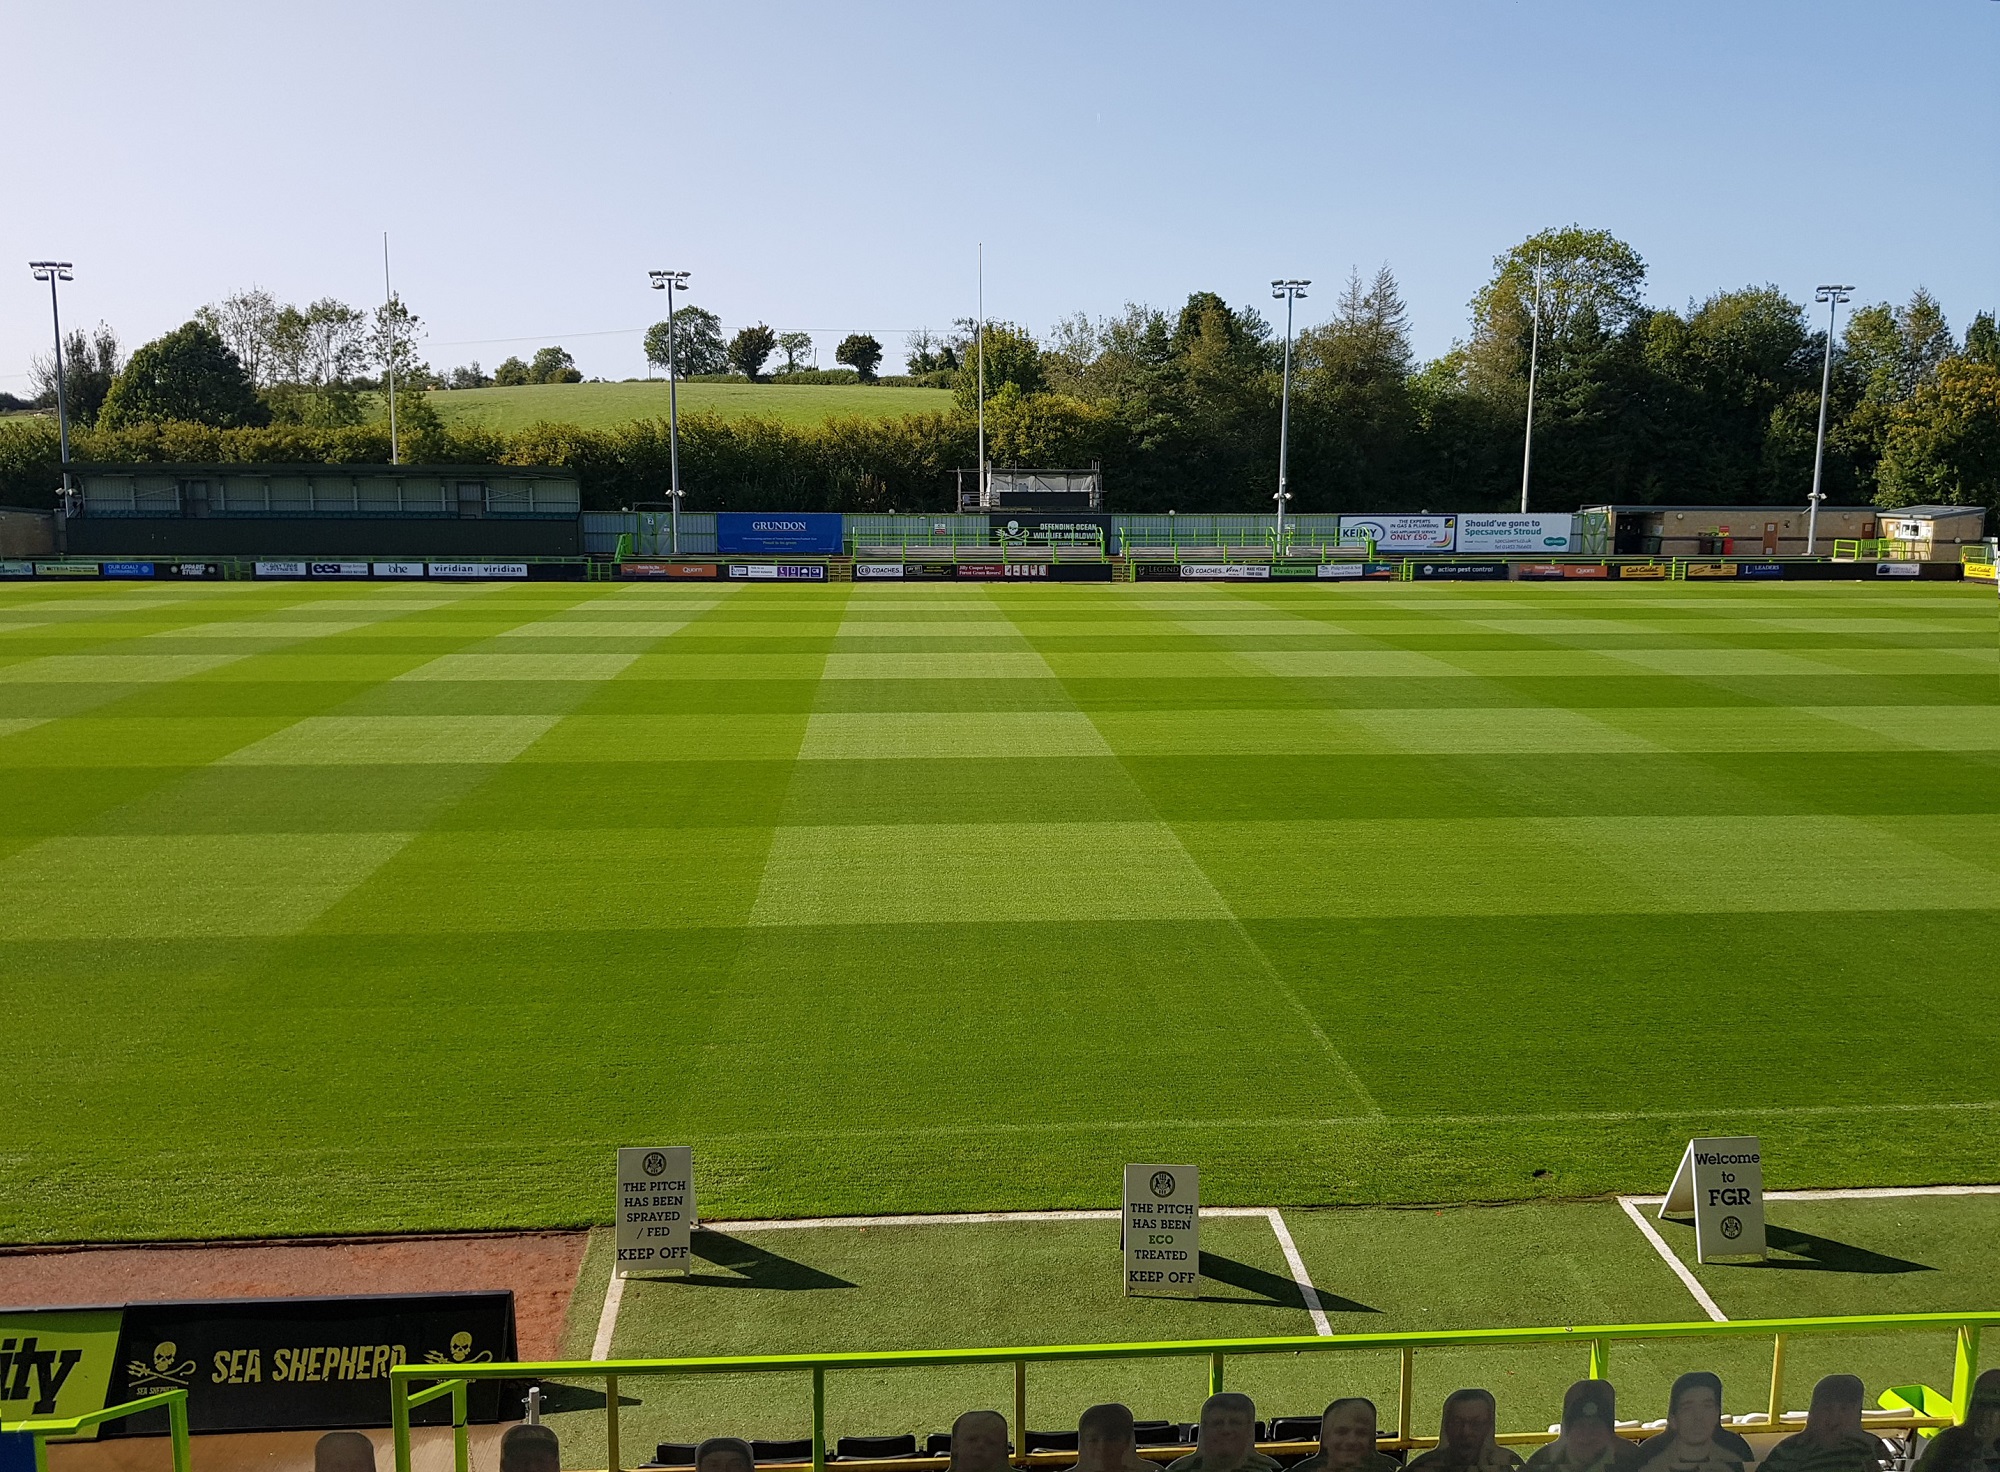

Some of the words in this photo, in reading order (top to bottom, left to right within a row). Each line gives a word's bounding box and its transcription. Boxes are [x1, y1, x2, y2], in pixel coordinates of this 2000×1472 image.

[752, 522, 807, 530] GRUNDON
[1465, 528, 1512, 536] Specsavers
[484, 565, 522, 573] viridian
[1695, 1153, 1760, 1165] Welcome
[1722, 1171, 1735, 1182] to
[623, 1182, 646, 1192] THE
[650, 1181, 686, 1191] PITCH
[624, 1198, 648, 1207] HAS
[652, 1196, 683, 1206] BEEN
[1708, 1188, 1751, 1206] FGR
[1131, 1203, 1153, 1213] THE
[1157, 1204, 1193, 1214] PITCH
[627, 1212, 680, 1222] SPRAYED
[1132, 1219, 1156, 1229] HAS
[1161, 1220, 1191, 1230] BEEN
[636, 1228, 644, 1239] /
[647, 1227, 670, 1237] FED
[1148, 1235, 1174, 1244] ECO
[618, 1248, 655, 1260] KEEP
[660, 1247, 688, 1259] OFF
[1134, 1250, 1187, 1260] TREATED
[1129, 1271, 1164, 1282] KEEP
[1168, 1272, 1195, 1283] OFF
[212, 1350, 261, 1384] SEA
[272, 1344, 406, 1382] SHEPHERD
